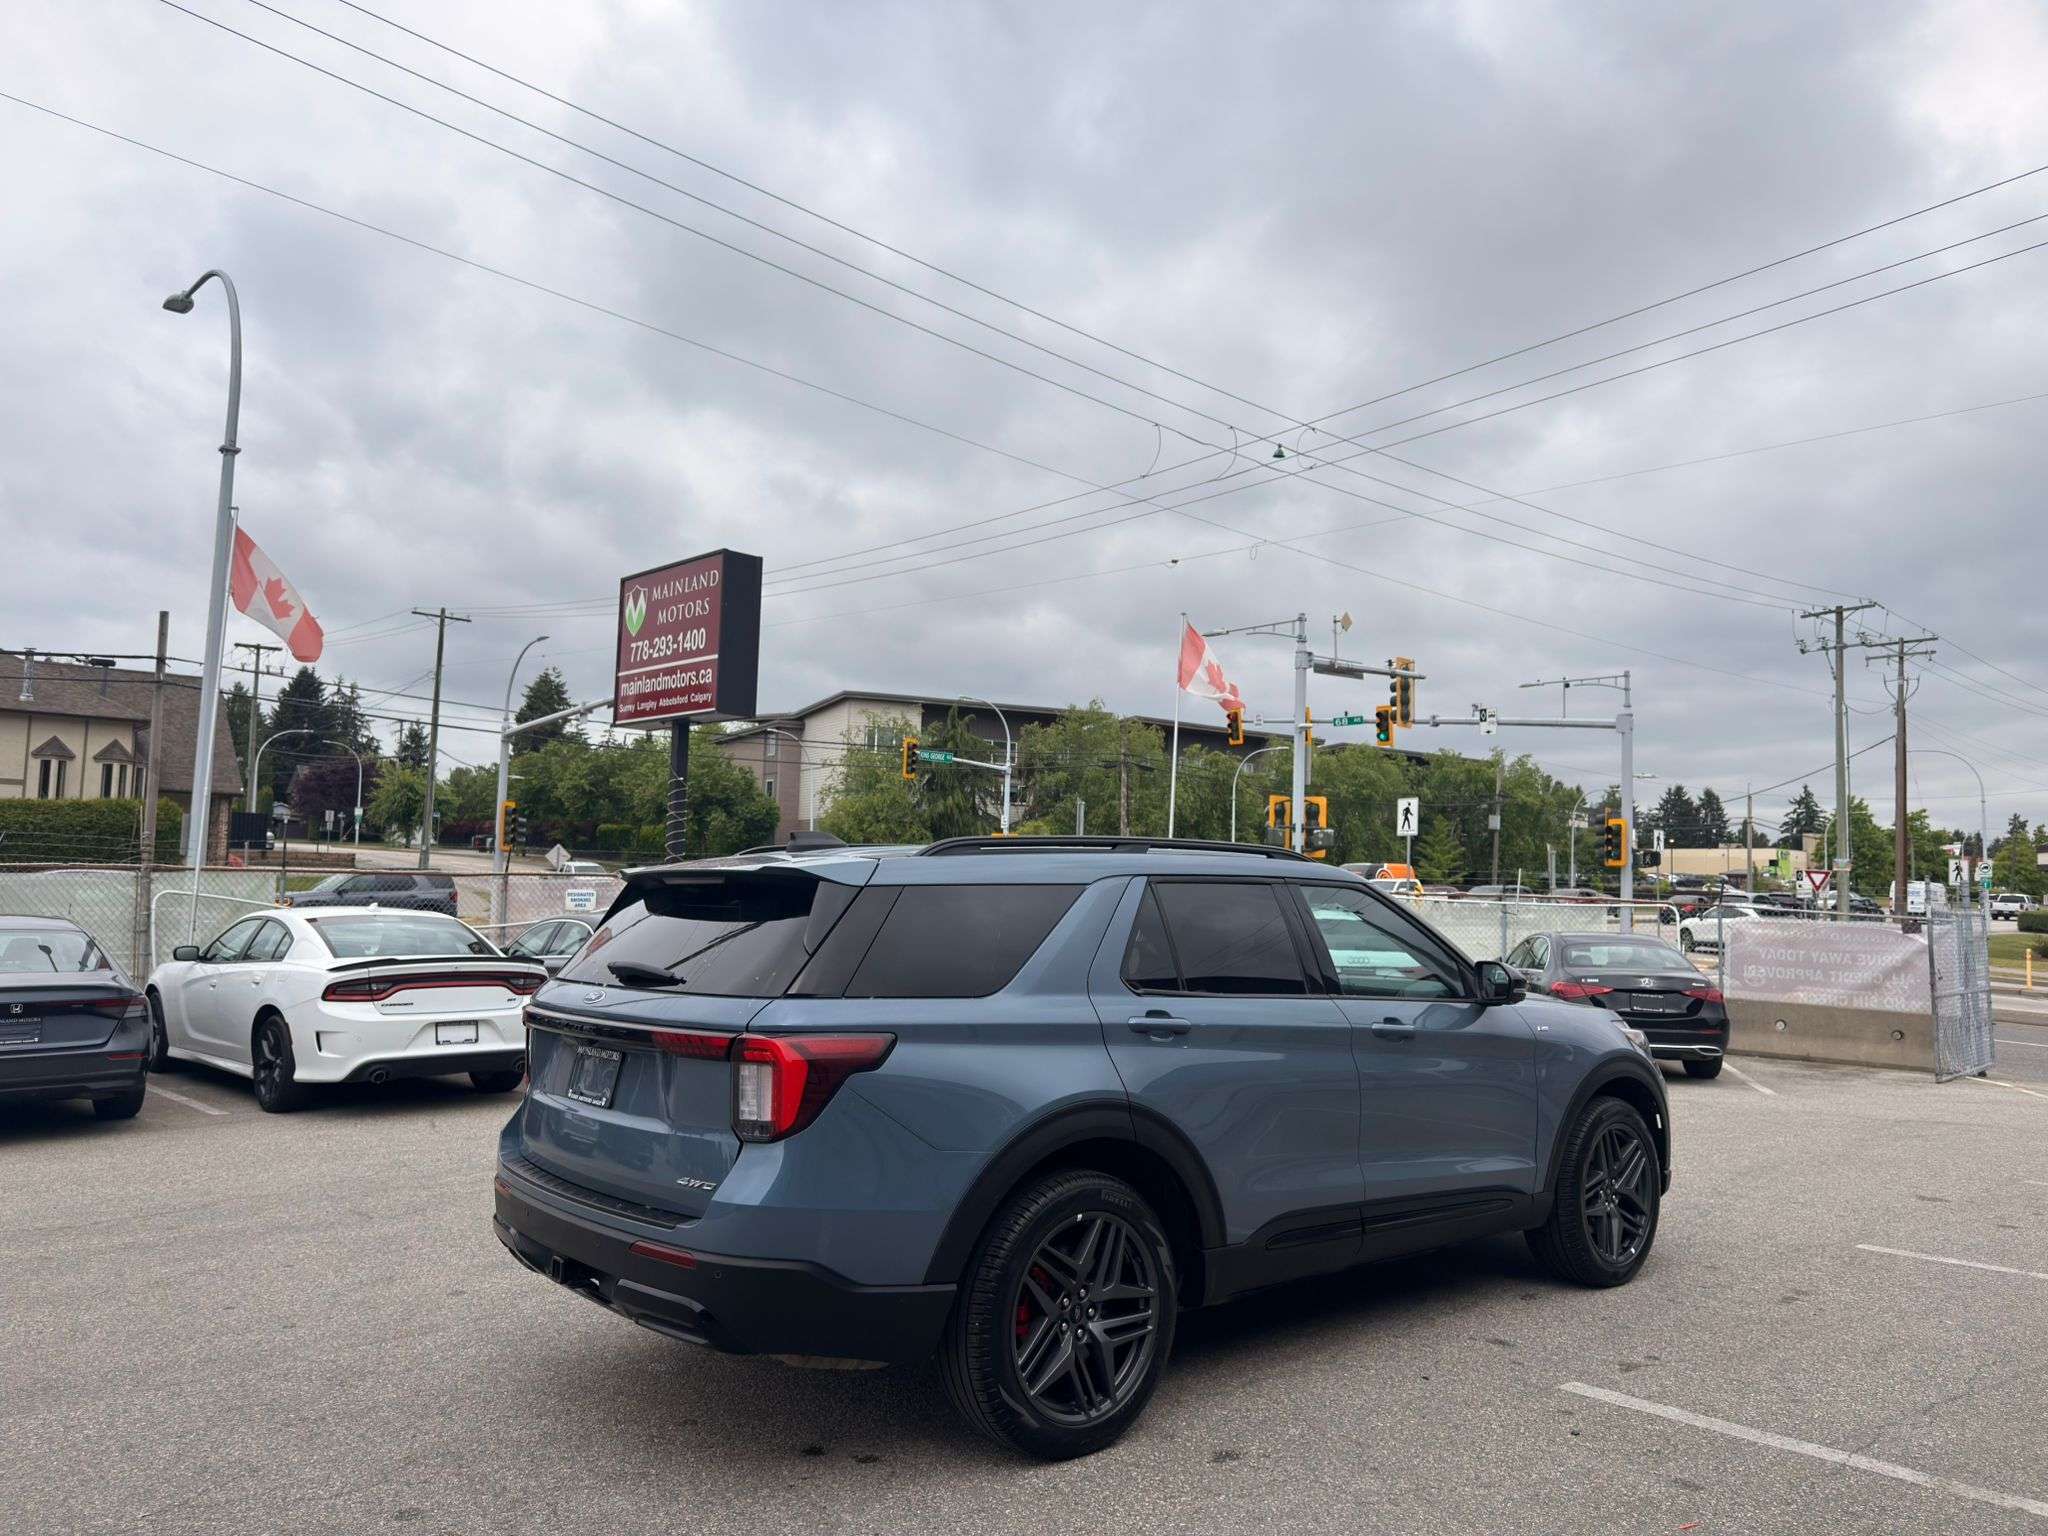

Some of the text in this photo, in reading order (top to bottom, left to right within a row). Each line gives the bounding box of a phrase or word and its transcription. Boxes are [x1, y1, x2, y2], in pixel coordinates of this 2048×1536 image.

[652, 569, 719, 601] MAINLAND
[657, 597, 710, 625] MOTORS
[630, 627, 706, 662] 778-293-1400
[621, 668, 713, 696] mainlandmotors.ca
[690, 692, 712, 704] Calgary
[1335, 718, 1348, 726] 68
[676, 1177, 717, 1190] 4WD
